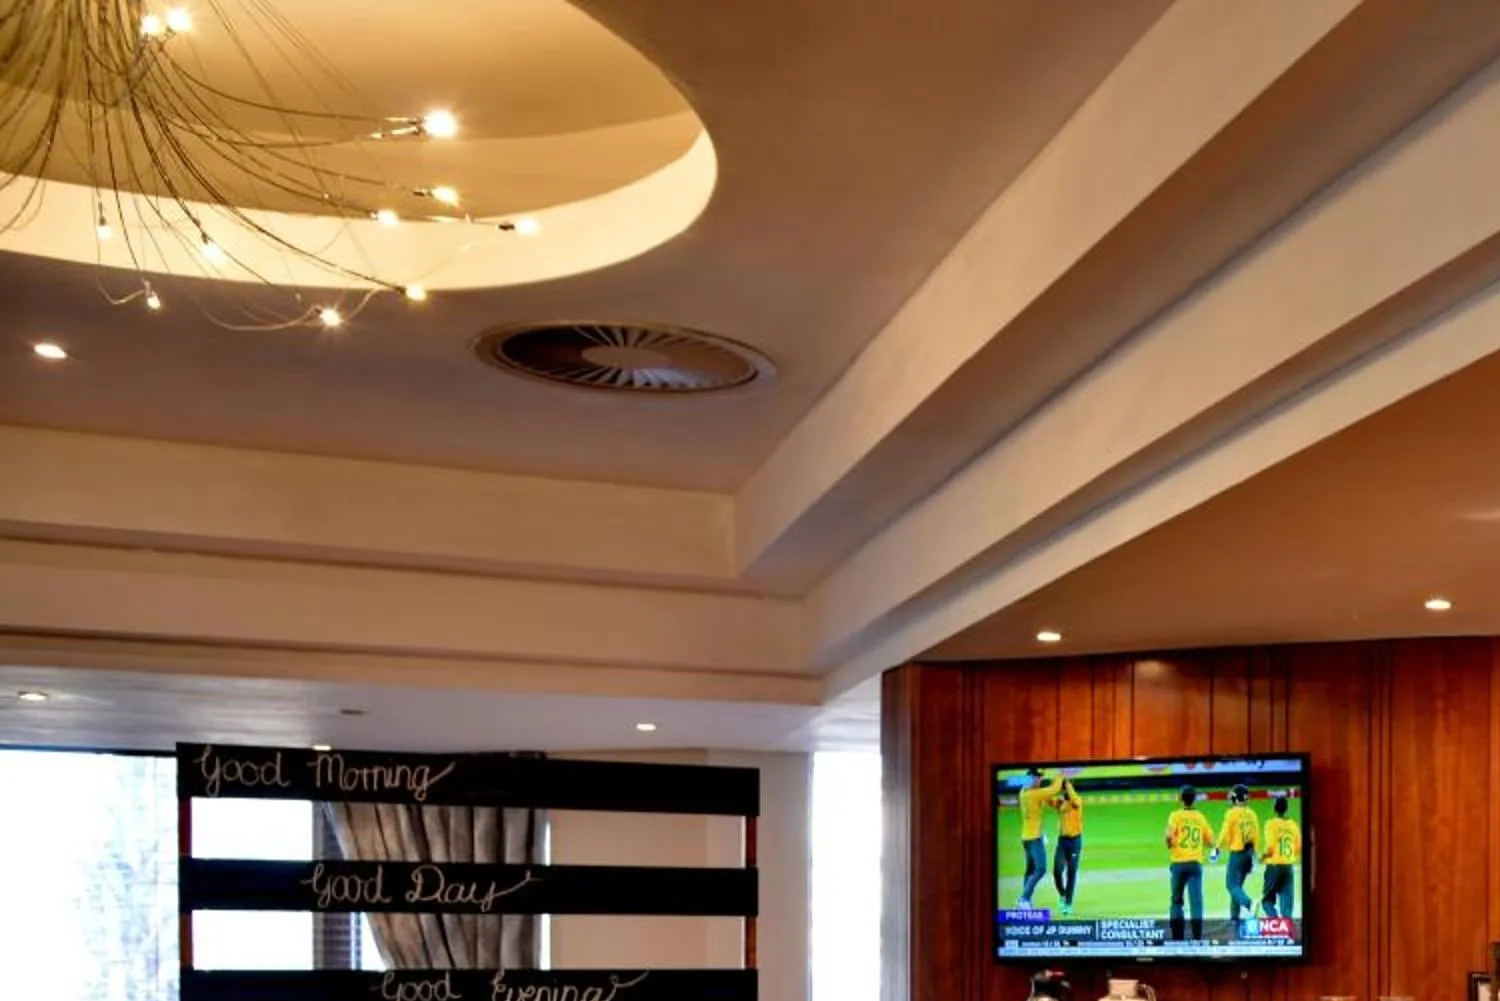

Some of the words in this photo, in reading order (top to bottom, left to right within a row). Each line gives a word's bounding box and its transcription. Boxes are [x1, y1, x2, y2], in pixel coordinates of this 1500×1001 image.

[192, 743, 291, 797] Good
[306, 753, 455, 801] Morning
[300, 863, 392, 907] Good
[405, 864, 542, 912] Day
[1101, 929, 1165, 939] CONSULTANT
